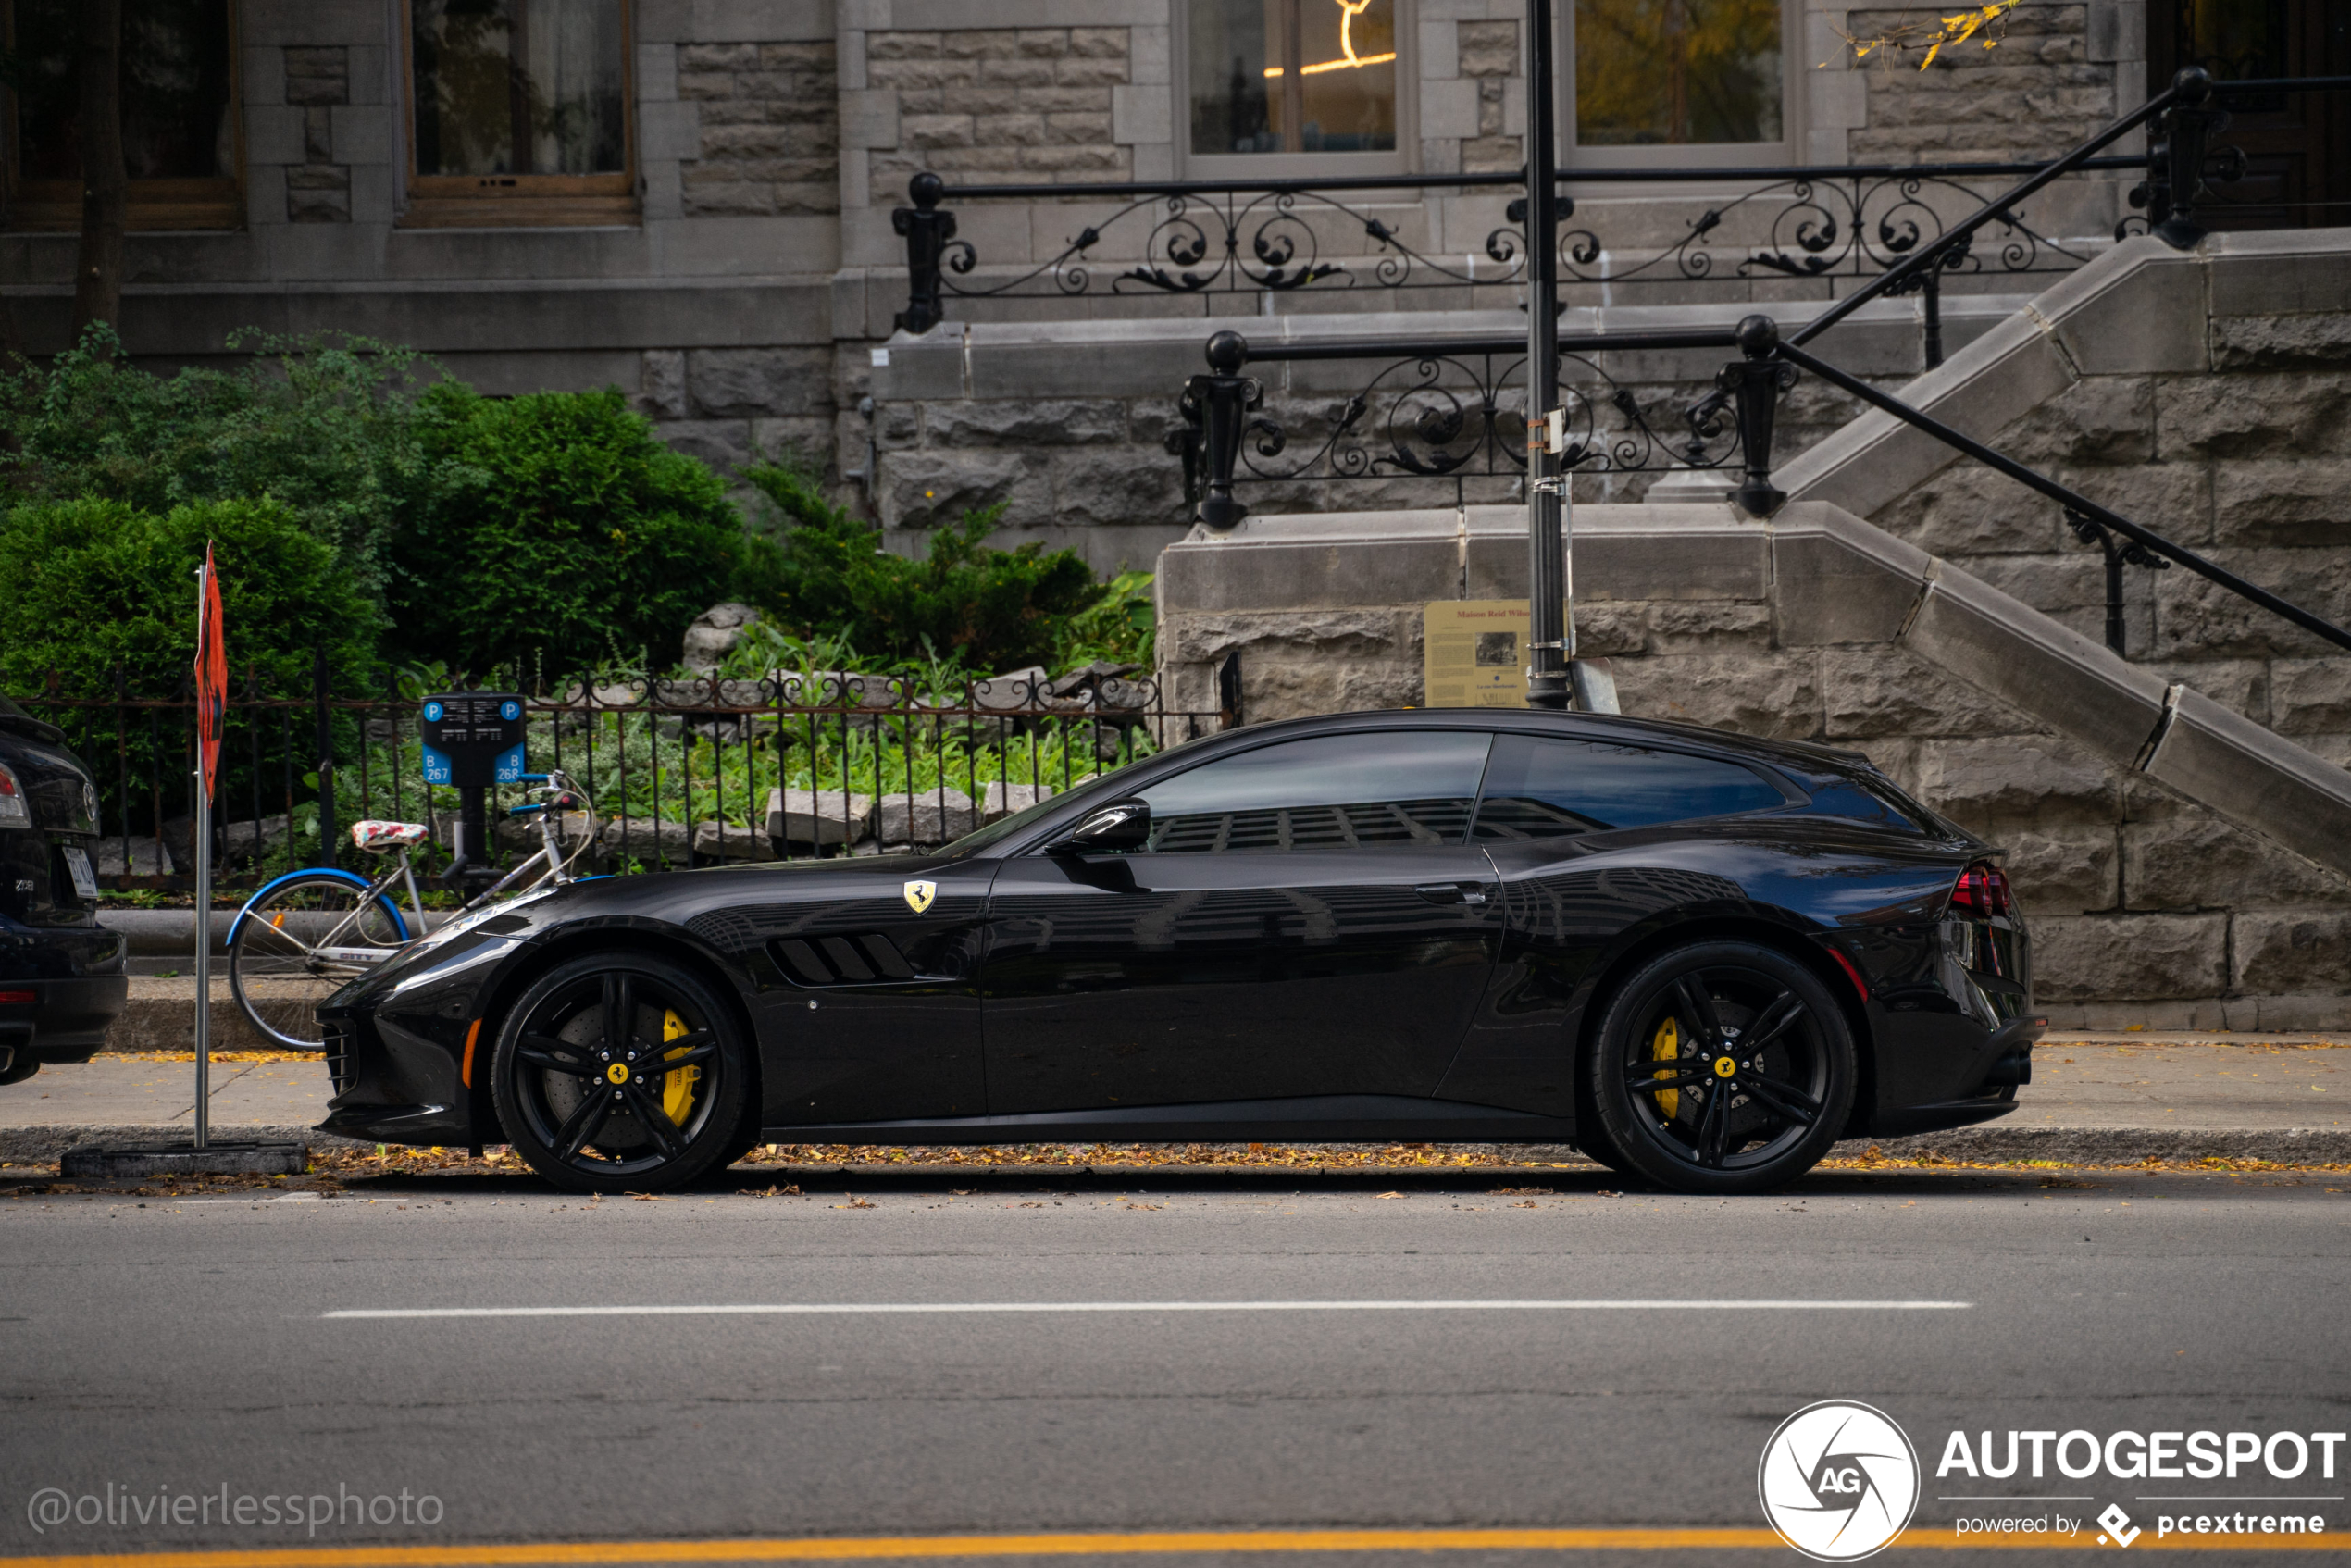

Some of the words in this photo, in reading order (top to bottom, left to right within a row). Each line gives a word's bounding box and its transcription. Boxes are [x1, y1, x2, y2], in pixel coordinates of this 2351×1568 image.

[1488, 610, 1506, 618] Reid
[1508, 609, 1531, 617] Wilso
[427, 755, 435, 767] B
[511, 755, 519, 766] B
[428, 768, 448, 780] 267
[498, 768, 519, 780] 268
